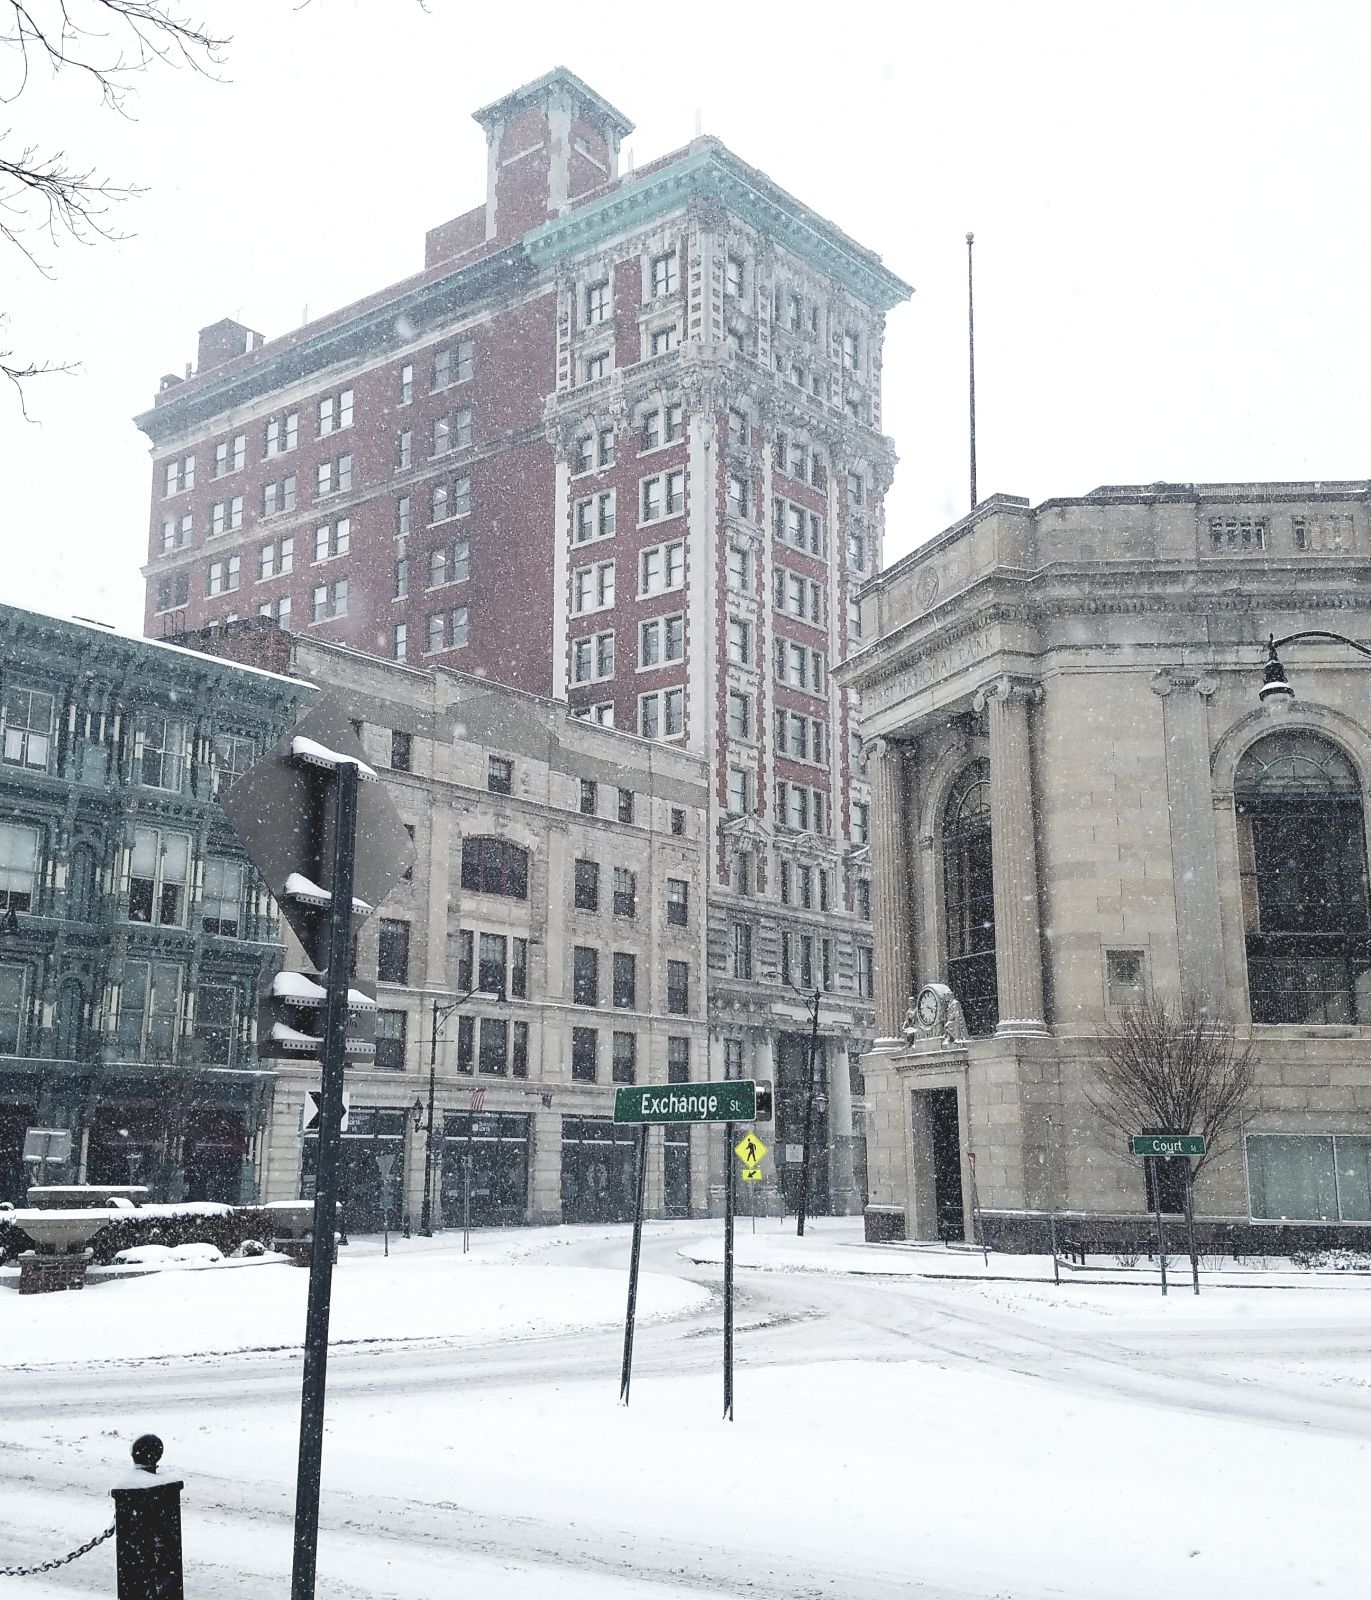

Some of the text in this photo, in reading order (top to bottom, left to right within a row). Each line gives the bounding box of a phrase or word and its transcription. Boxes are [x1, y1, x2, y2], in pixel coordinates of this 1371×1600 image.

[641, 1092, 740, 1119] Exchange St
[1152, 1140, 1183, 1152] Court
